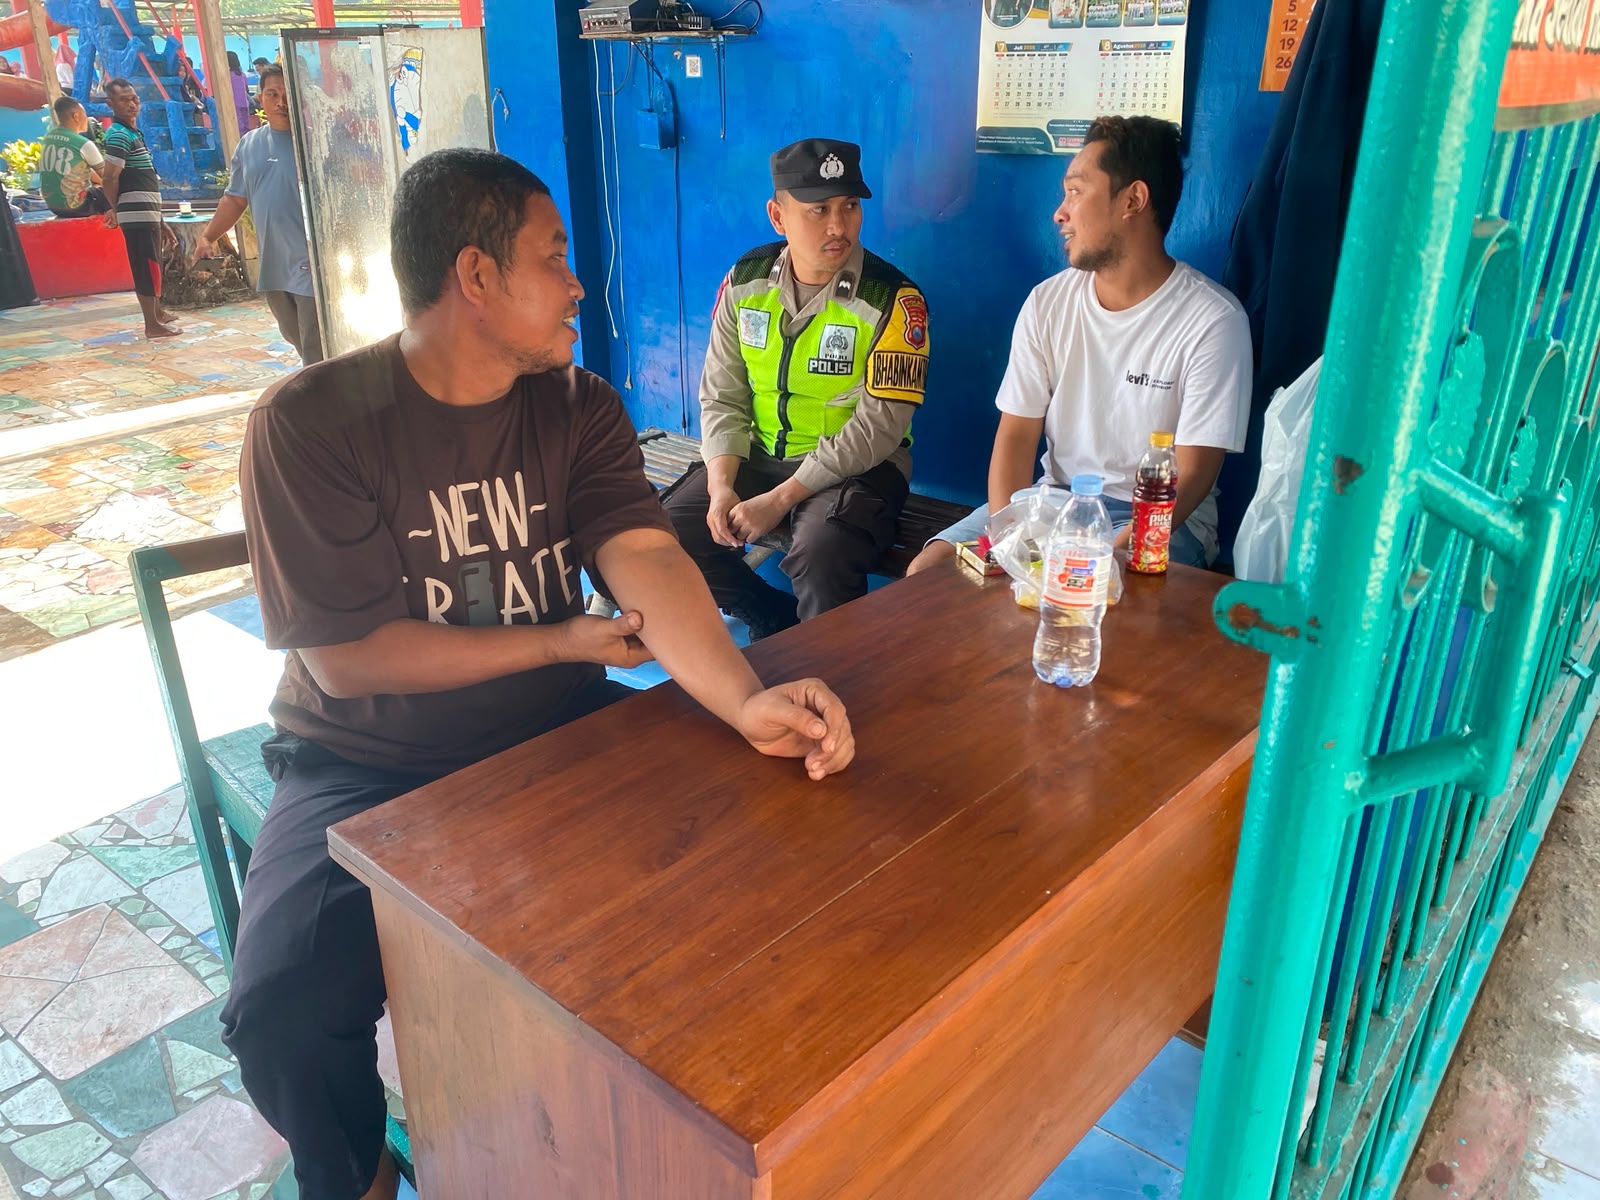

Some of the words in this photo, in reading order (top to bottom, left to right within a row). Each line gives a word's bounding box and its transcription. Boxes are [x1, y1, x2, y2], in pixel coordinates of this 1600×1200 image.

[1288, 0, 1297, 12] 5
[1282, 19, 1298, 32] 12
[1279, 38, 1296, 50] 19
[1275, 56, 1292, 69] 26
[809, 359, 852, 374] POLISI
[875, 353, 928, 389] BHABINKAM
[402, 537, 577, 626] REATE
